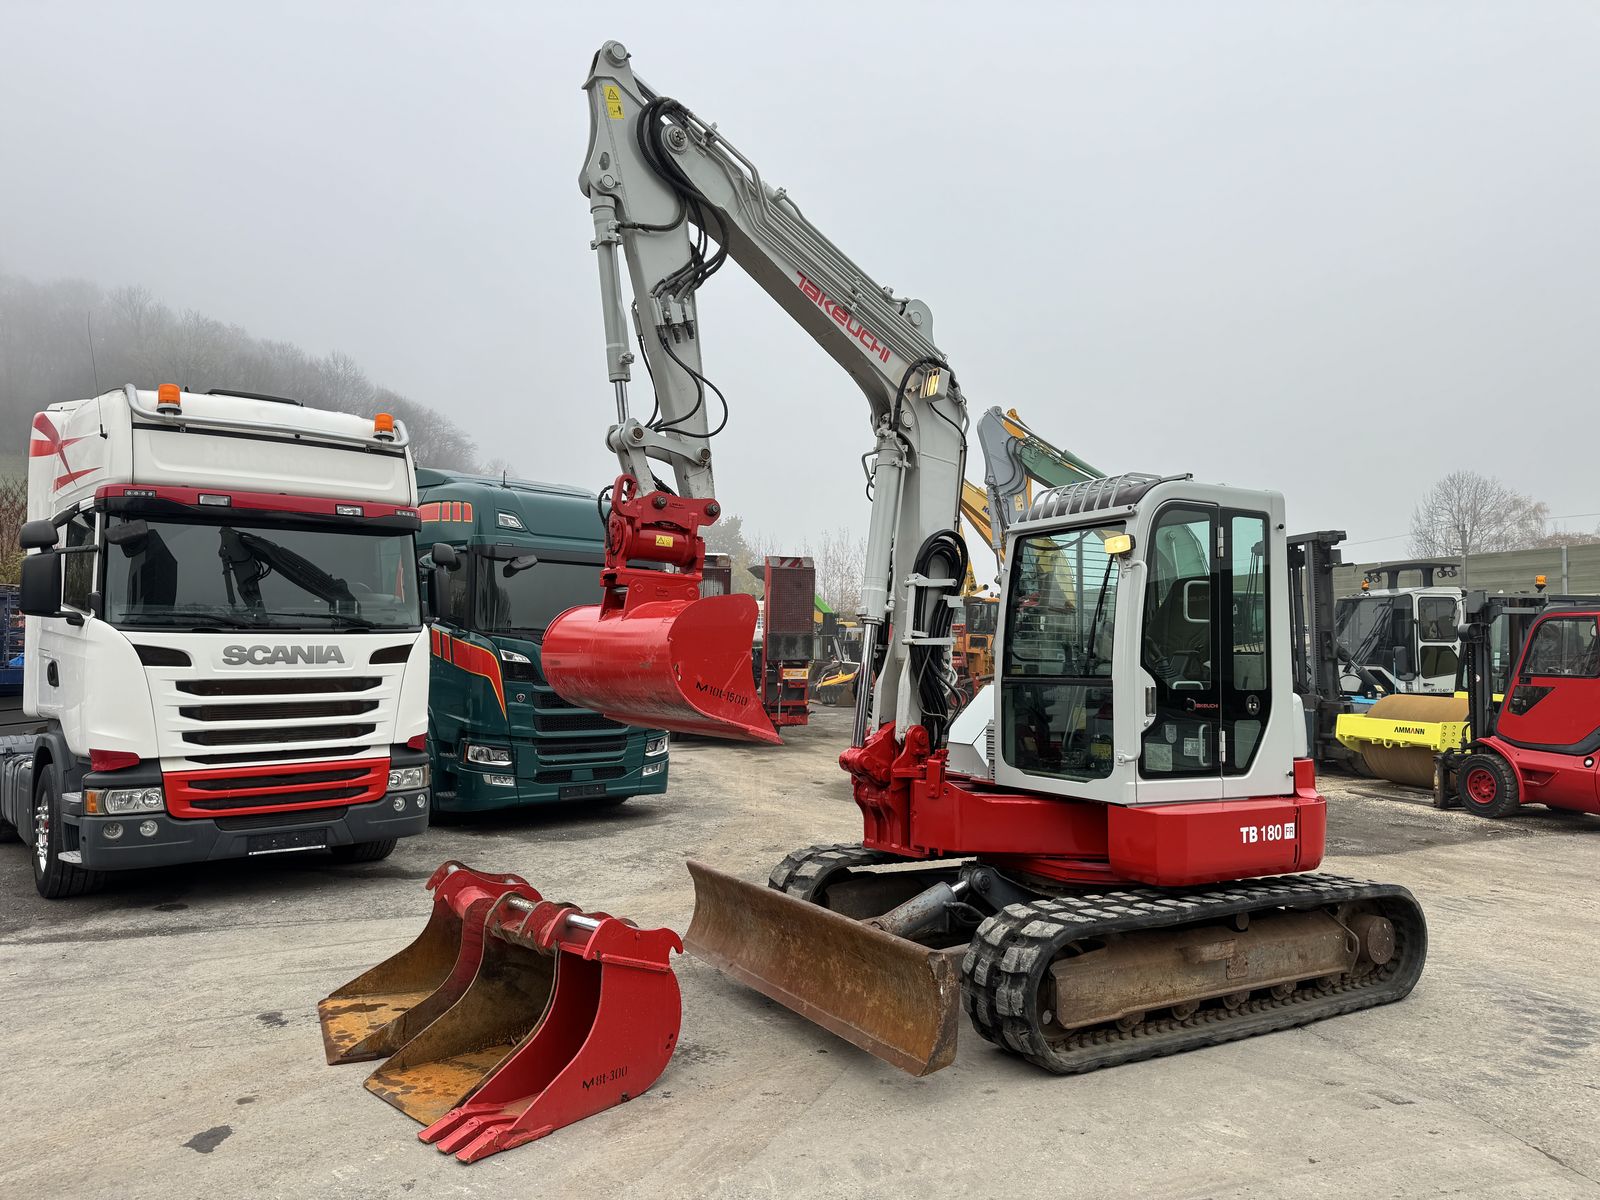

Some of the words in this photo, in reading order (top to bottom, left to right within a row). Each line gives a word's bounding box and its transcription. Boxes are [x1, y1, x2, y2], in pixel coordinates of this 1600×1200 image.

[222, 645, 345, 665] SCANIA
[1393, 726, 1425, 735] AMMANN
[1239, 826, 1258, 844] TB
[1260, 824, 1282, 841] 180
